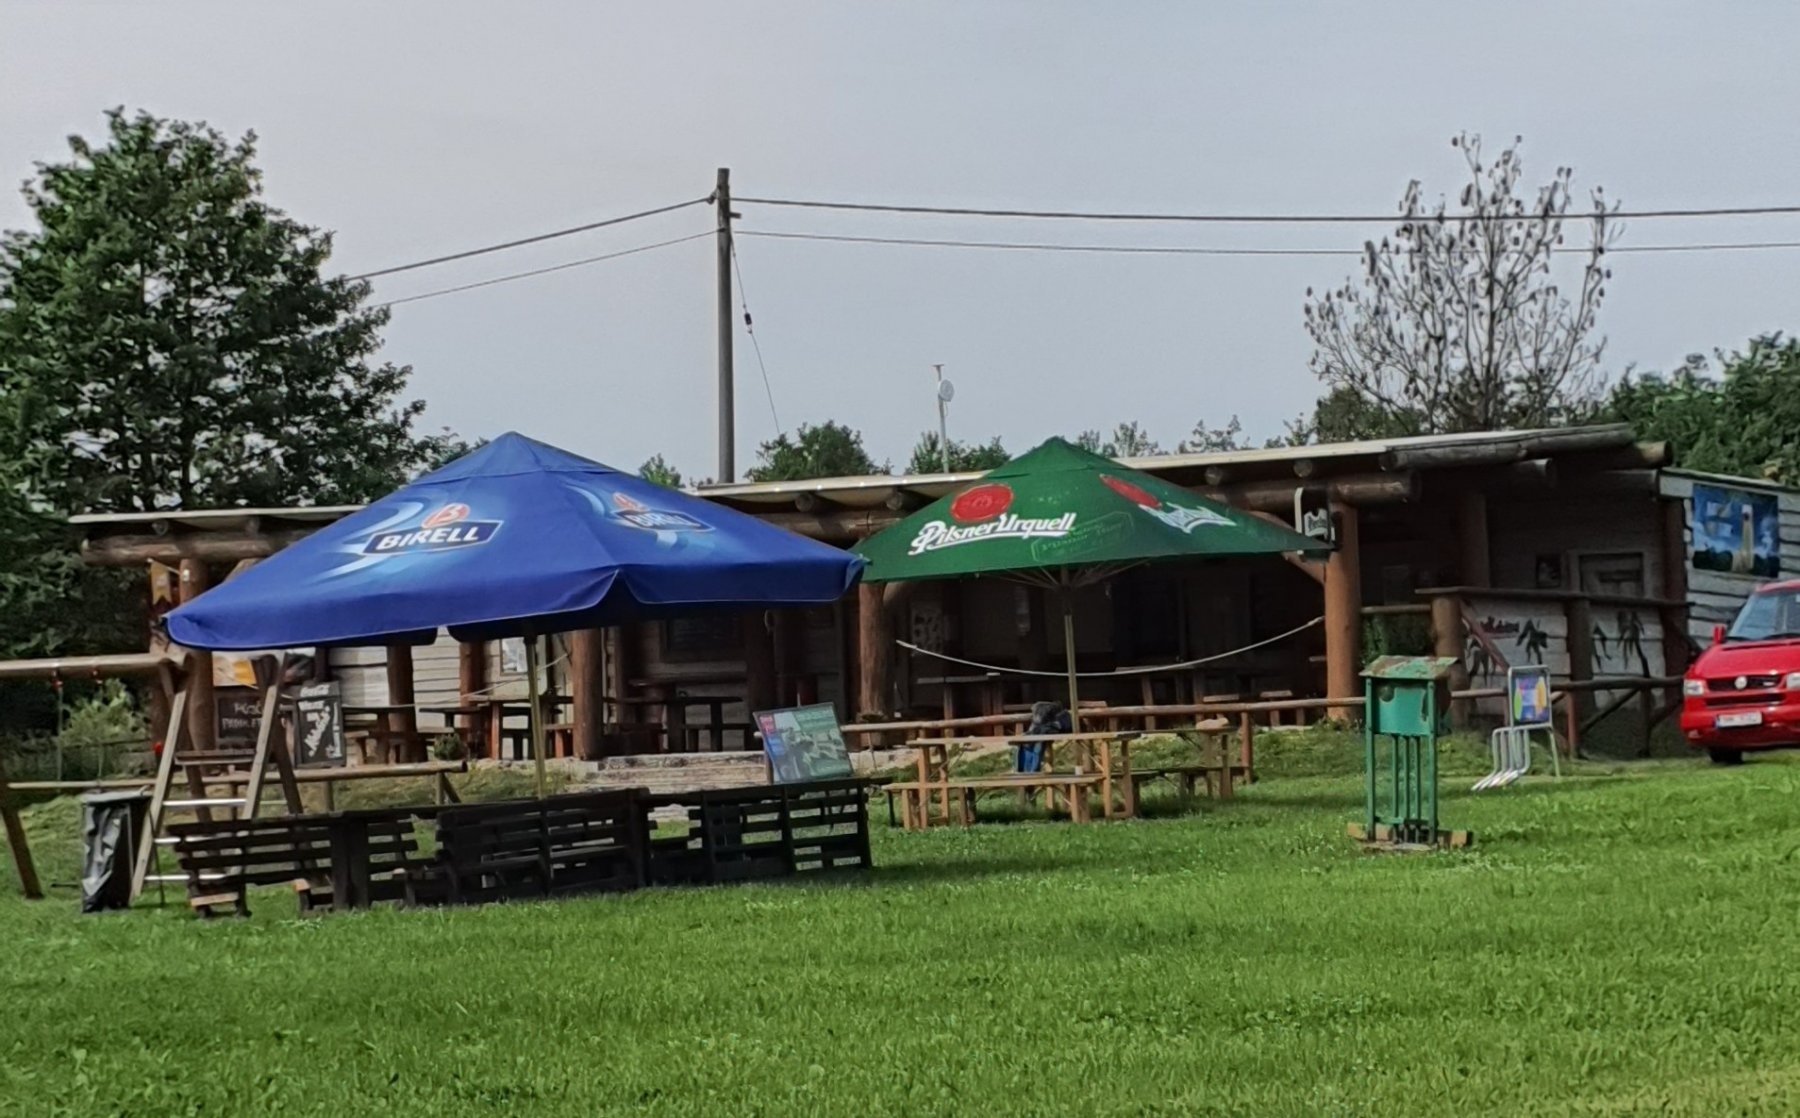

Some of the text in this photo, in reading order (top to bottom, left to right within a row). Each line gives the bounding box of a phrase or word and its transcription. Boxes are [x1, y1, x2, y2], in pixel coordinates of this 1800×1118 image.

[375, 526, 479, 550] BIRELL
[907, 520, 999, 556] Pilsner
[995, 512, 1077, 540] Urquell
